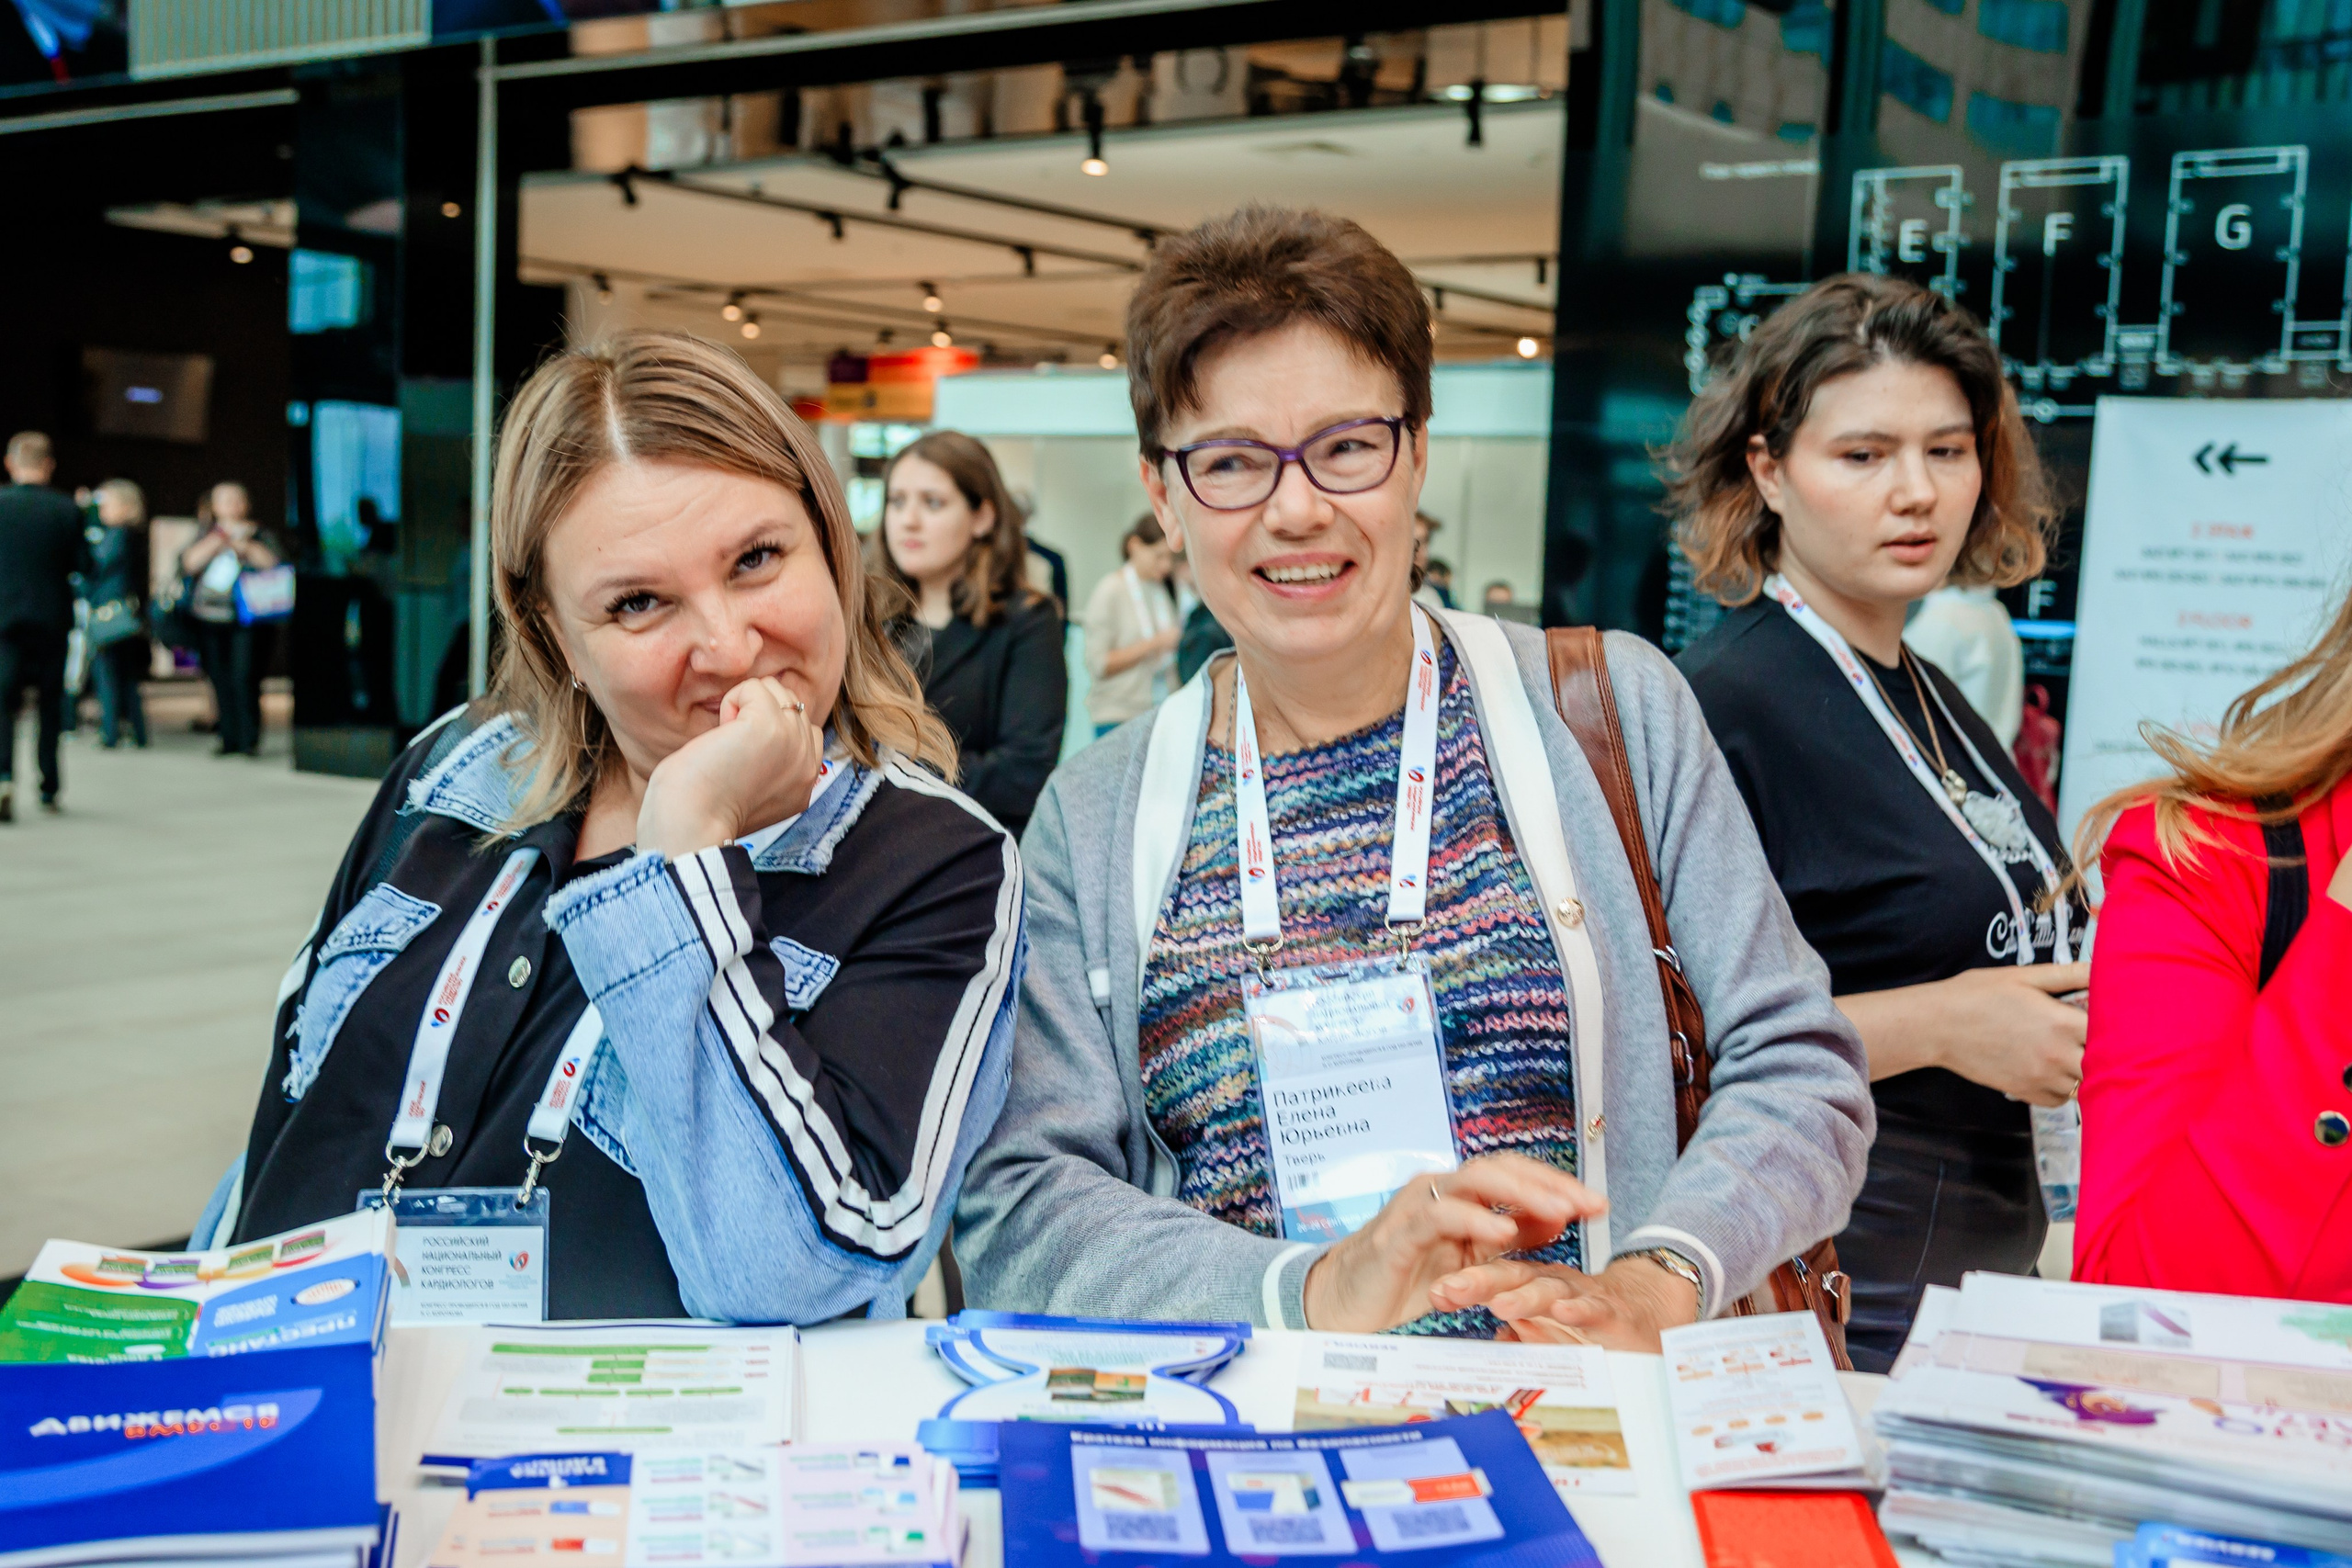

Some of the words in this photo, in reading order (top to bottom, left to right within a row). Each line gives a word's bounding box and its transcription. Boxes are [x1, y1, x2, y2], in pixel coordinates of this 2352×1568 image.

[2042, 212, 2075, 256] F
[2214, 204, 2253, 250] G
[1899, 219, 1928, 263] E
[2028, 579, 2058, 620] F
[1272, 1075, 1393, 1109] Патрикеева
[1276, 1104, 1337, 1127] Елена
[1279, 1118, 1372, 1146] Юрьевна
[1283, 1151, 1326, 1168] Тверь
[422, 1235, 490, 1247] РОССИЙСКИЙ
[422, 1248, 503, 1262] НАЦИОНАЛЬНЫЙ
[421, 1264, 472, 1277] КОНГРЕСС
[420, 1278, 494, 1291] КАРДИОЛОГОВ
